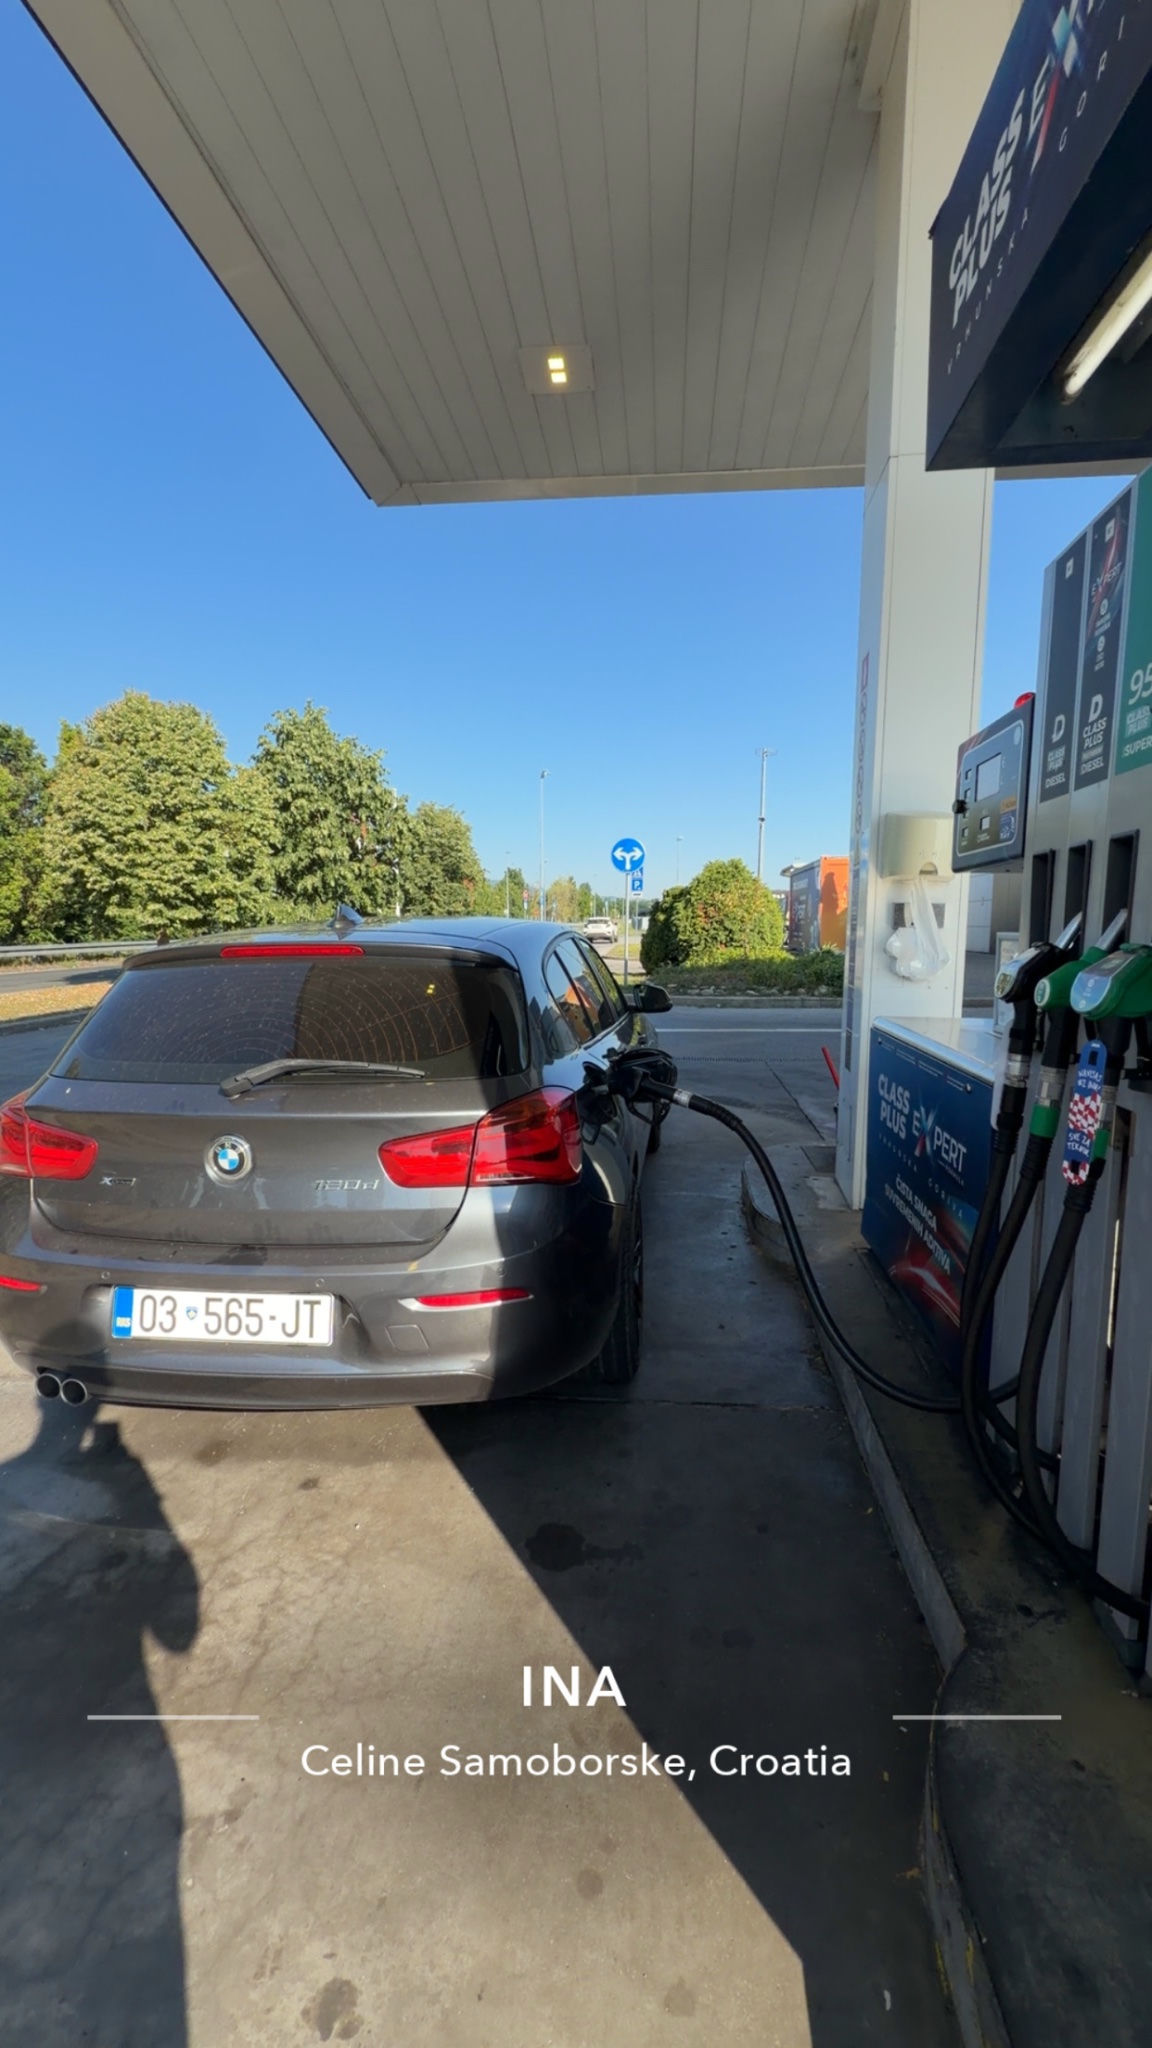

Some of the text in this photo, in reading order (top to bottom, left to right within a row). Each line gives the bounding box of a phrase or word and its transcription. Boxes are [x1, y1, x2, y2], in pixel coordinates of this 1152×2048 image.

[947, 0, 1141, 376] VRHUNSKA GORI
[949, 88, 1026, 290] CLASS
[952, 165, 1013, 330] PLUS
[1088, 693, 1103, 723] D
[1052, 714, 1066, 743] D
[1082, 717, 1107, 738] CLASS
[1083, 731, 1103, 750] PLUS
[1126, 717, 1149, 737] PLUS
[1045, 772, 1066, 789] DIESEL
[1080, 756, 1104, 775] DIESEL
[878, 1073, 967, 1173] CLASS EXPERT
[880, 1100, 907, 1140] PLUS
[914, 1194, 937, 1232] SNAGA
[139, 1294, 178, 1333] 03
[203, 1296, 322, 1339] 565-JT
